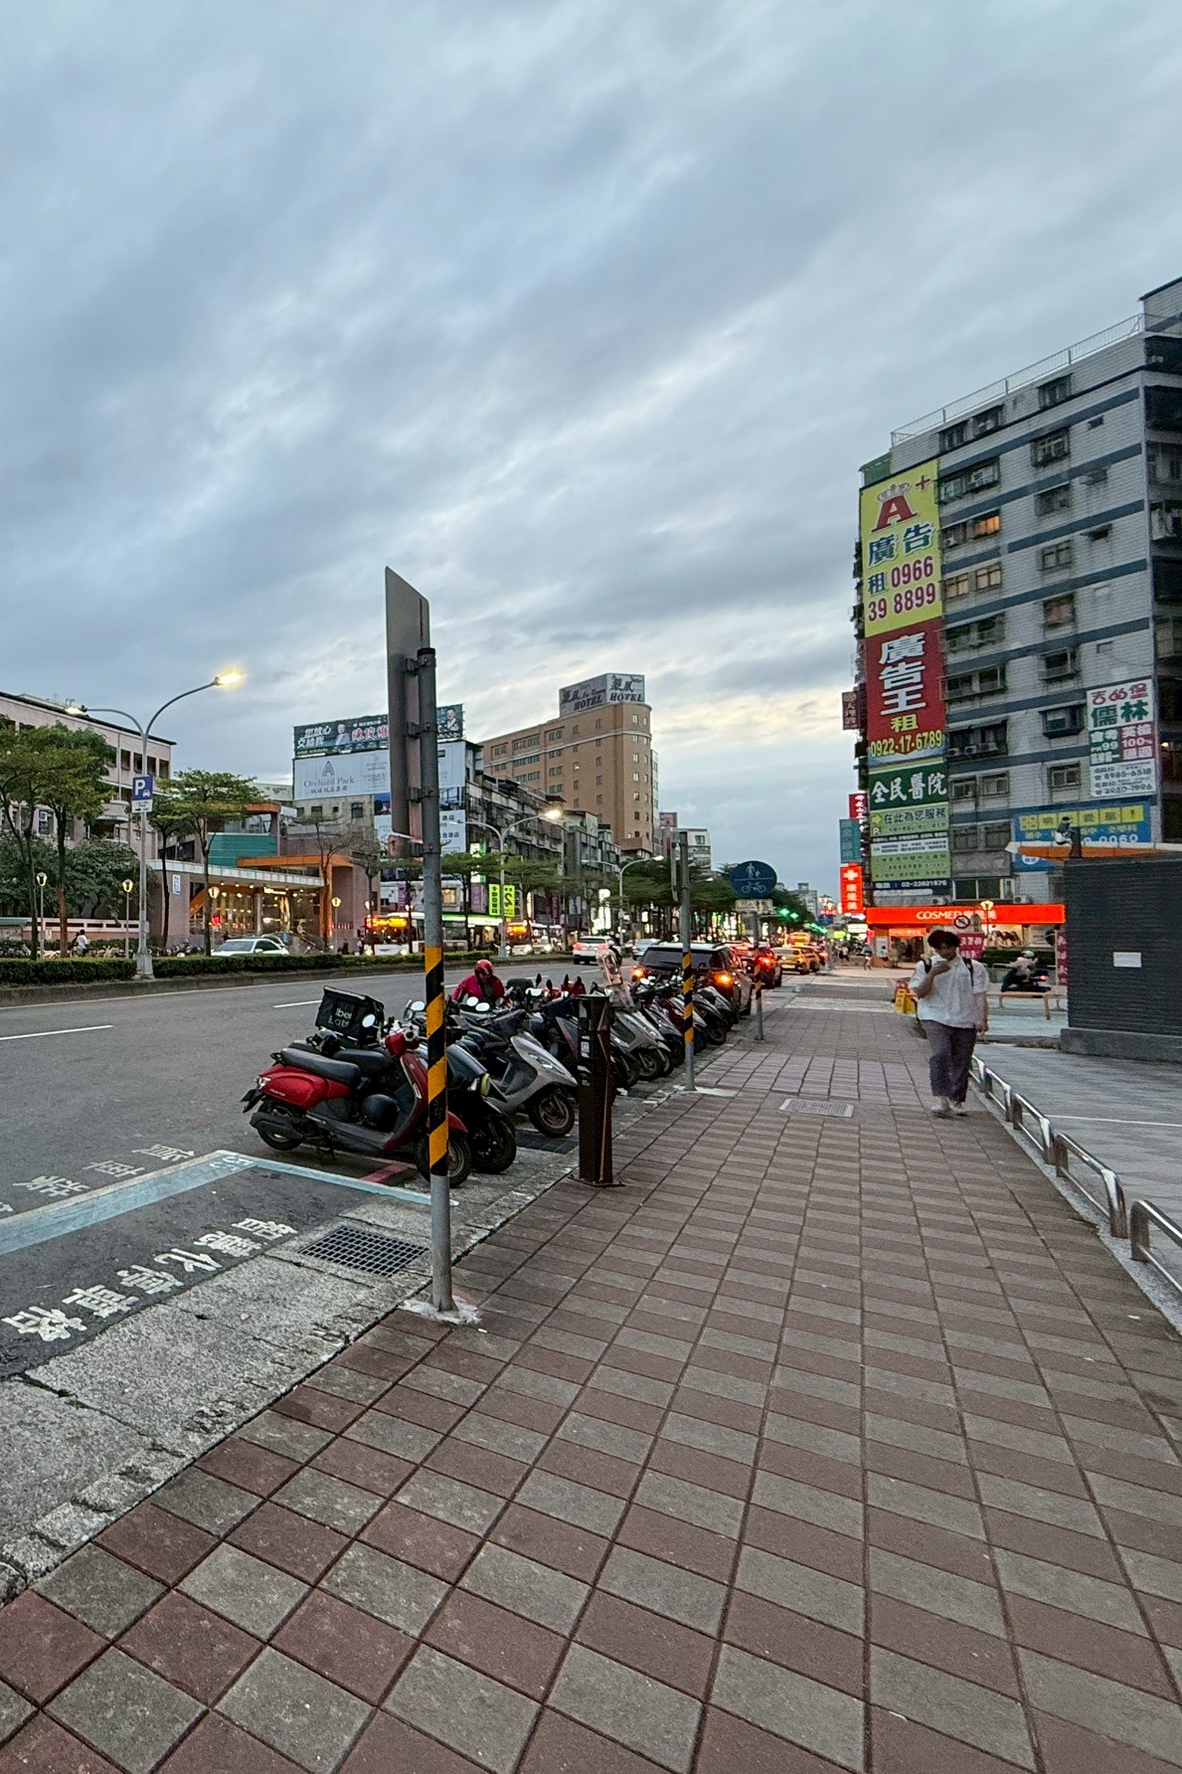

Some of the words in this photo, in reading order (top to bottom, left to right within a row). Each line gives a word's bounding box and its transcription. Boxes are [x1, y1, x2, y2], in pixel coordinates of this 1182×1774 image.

[868, 523, 934, 567] 廣告
[868, 572, 888, 595] 租
[891, 555, 934, 588] 0966
[868, 597, 888, 622] 39
[893, 583, 936, 614] 8899
[574, 695, 604, 711] HOTEL
[609, 692, 644, 702] HOTEL
[890, 714, 919, 733] 租
[1090, 699, 1149, 728] 儒林
[134, 779, 146, 796] P
[304, 778, 335, 788] Orchard
[337, 776, 355, 785] Park
[871, 772, 948, 805] 全民醫院
[1, 1217, 298, 1342] 智慧化停車格
